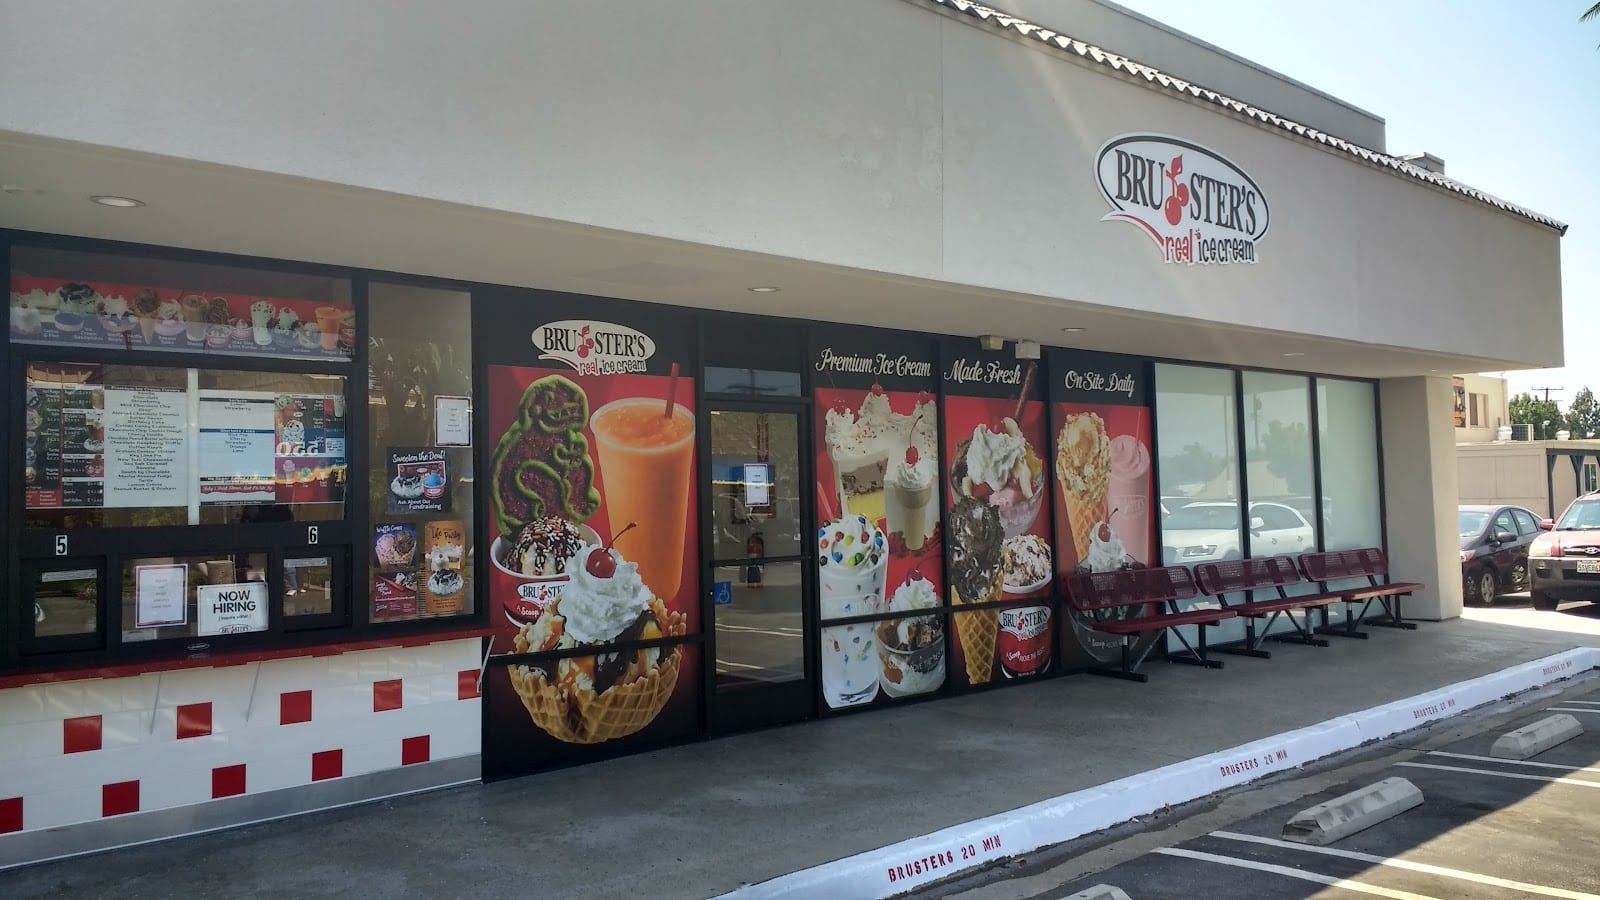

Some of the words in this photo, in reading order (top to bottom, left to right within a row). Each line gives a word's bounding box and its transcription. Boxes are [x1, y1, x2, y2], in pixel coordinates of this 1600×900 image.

[1115, 149, 1256, 235] BRUSTER'S
[1165, 229, 1193, 263] real
[543, 327, 646, 357] BRUSTER'S
[579, 358, 599, 375] real
[602, 360, 616, 373] ice
[617, 359, 646, 373] cream
[815, 348, 873, 373] Premium
[873, 354, 894, 376] Ice
[895, 354, 931, 377] Cream
[944, 358, 983, 384] Made
[983, 361, 1021, 385] Fresh
[1065, 370, 1083, 390] On
[1084, 372, 1104, 391] Site
[1105, 372, 1135, 398] Daily
[393, 453, 418, 463] Sweeten
[419, 451, 429, 461] the
[429, 450, 446, 460] Deal!
[56, 537, 67, 554] 5
[308, 527, 317, 544] 6
[219, 590, 251, 602] NOW
[213, 601, 256, 614] HIRING
[521, 606, 540, 617] Scoop
[1003, 608, 1048, 628] BRUSTER'S
[1413, 704, 1439, 719] BRUSTERS
[1220, 758, 1259, 777] BRUSTERS
[1264, 754, 1273, 766] 20
[1276, 749, 1288, 761] MIN
[888, 851, 954, 883] BRUSTERS
[961, 844, 976, 860] 20
[982, 835, 1002, 852] MIN
